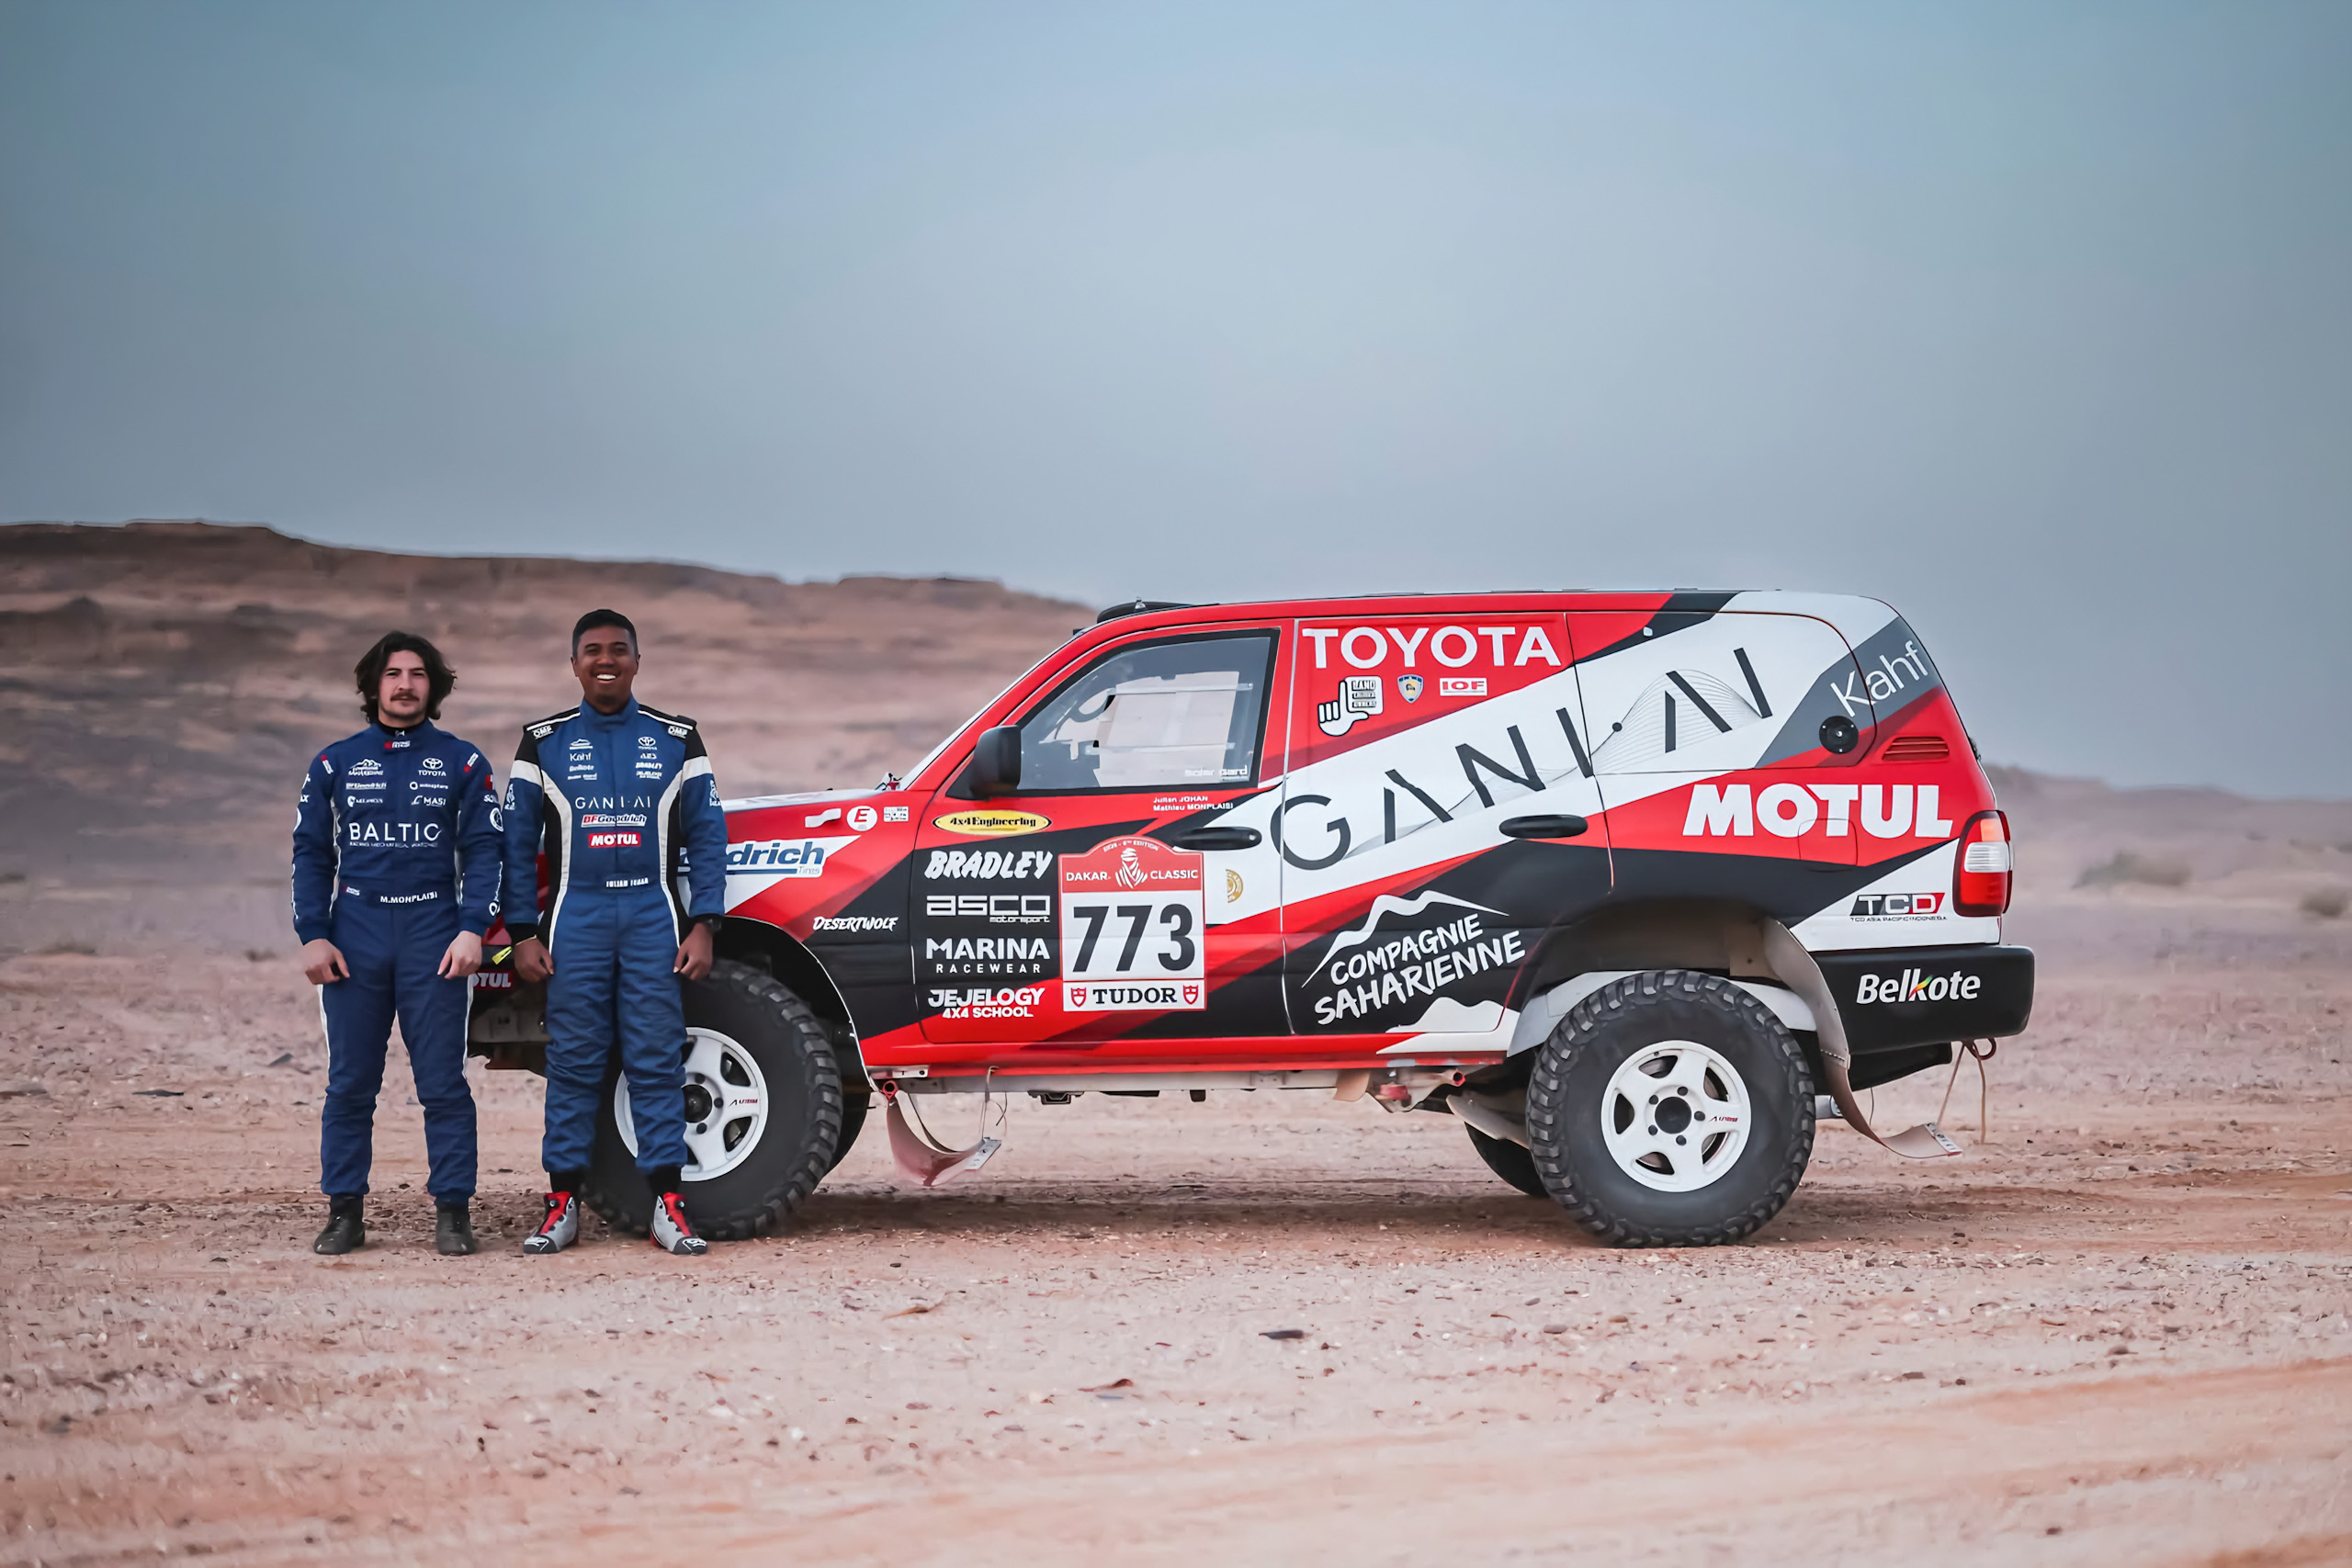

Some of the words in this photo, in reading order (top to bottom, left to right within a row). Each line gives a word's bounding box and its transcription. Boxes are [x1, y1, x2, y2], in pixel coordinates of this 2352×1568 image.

[1302, 626, 1562, 669] TOYOTA
[1830, 641, 1928, 717] Kahf
[854, 808, 870, 822] E
[1682, 783, 1953, 839] MOTUL
[349, 822, 442, 841] BALTIC
[591, 834, 638, 846] MOTUL
[924, 850, 1053, 879] BRADLEY
[1066, 872, 1107, 881] DAKAR
[1150, 870, 1198, 879] CLASSIC
[1858, 894, 1937, 915] TCD
[989, 916, 1050, 924] motorsport
[926, 938, 1050, 959] MARINA
[1072, 904, 1195, 972] 773
[1330, 913, 1484, 986] COMPAGNIE
[936, 964, 1040, 973] RACEWEAR
[1315, 931, 1526, 1024] SAHARIENNE
[1092, 987, 1177, 1004] TUDOR
[1856, 968, 1981, 1004] Belkote
[928, 987, 1046, 1007] JEJELOGY
[943, 1007, 968, 1018] 4X4
[973, 1007, 1034, 1018] SCHOOL
